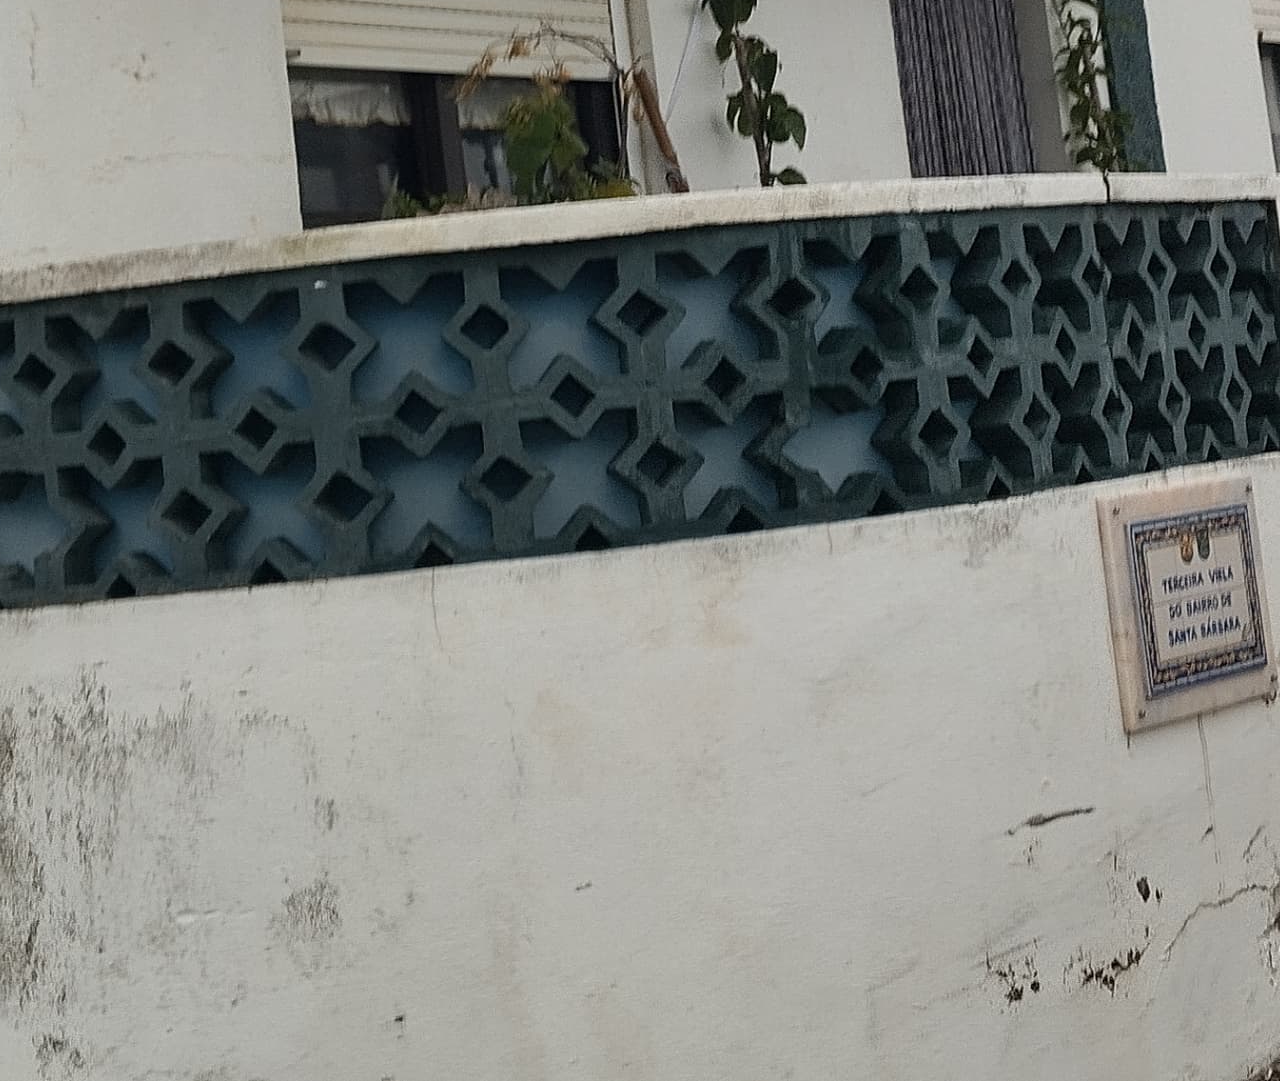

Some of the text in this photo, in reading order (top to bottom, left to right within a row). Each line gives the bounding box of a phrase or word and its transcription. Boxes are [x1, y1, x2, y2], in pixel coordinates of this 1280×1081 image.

[1162, 565, 1234, 594] TERCEIRA VIELA
[1169, 592, 1232, 618] DO BAIRRO DE
[1168, 625, 1197, 647] SANTA
